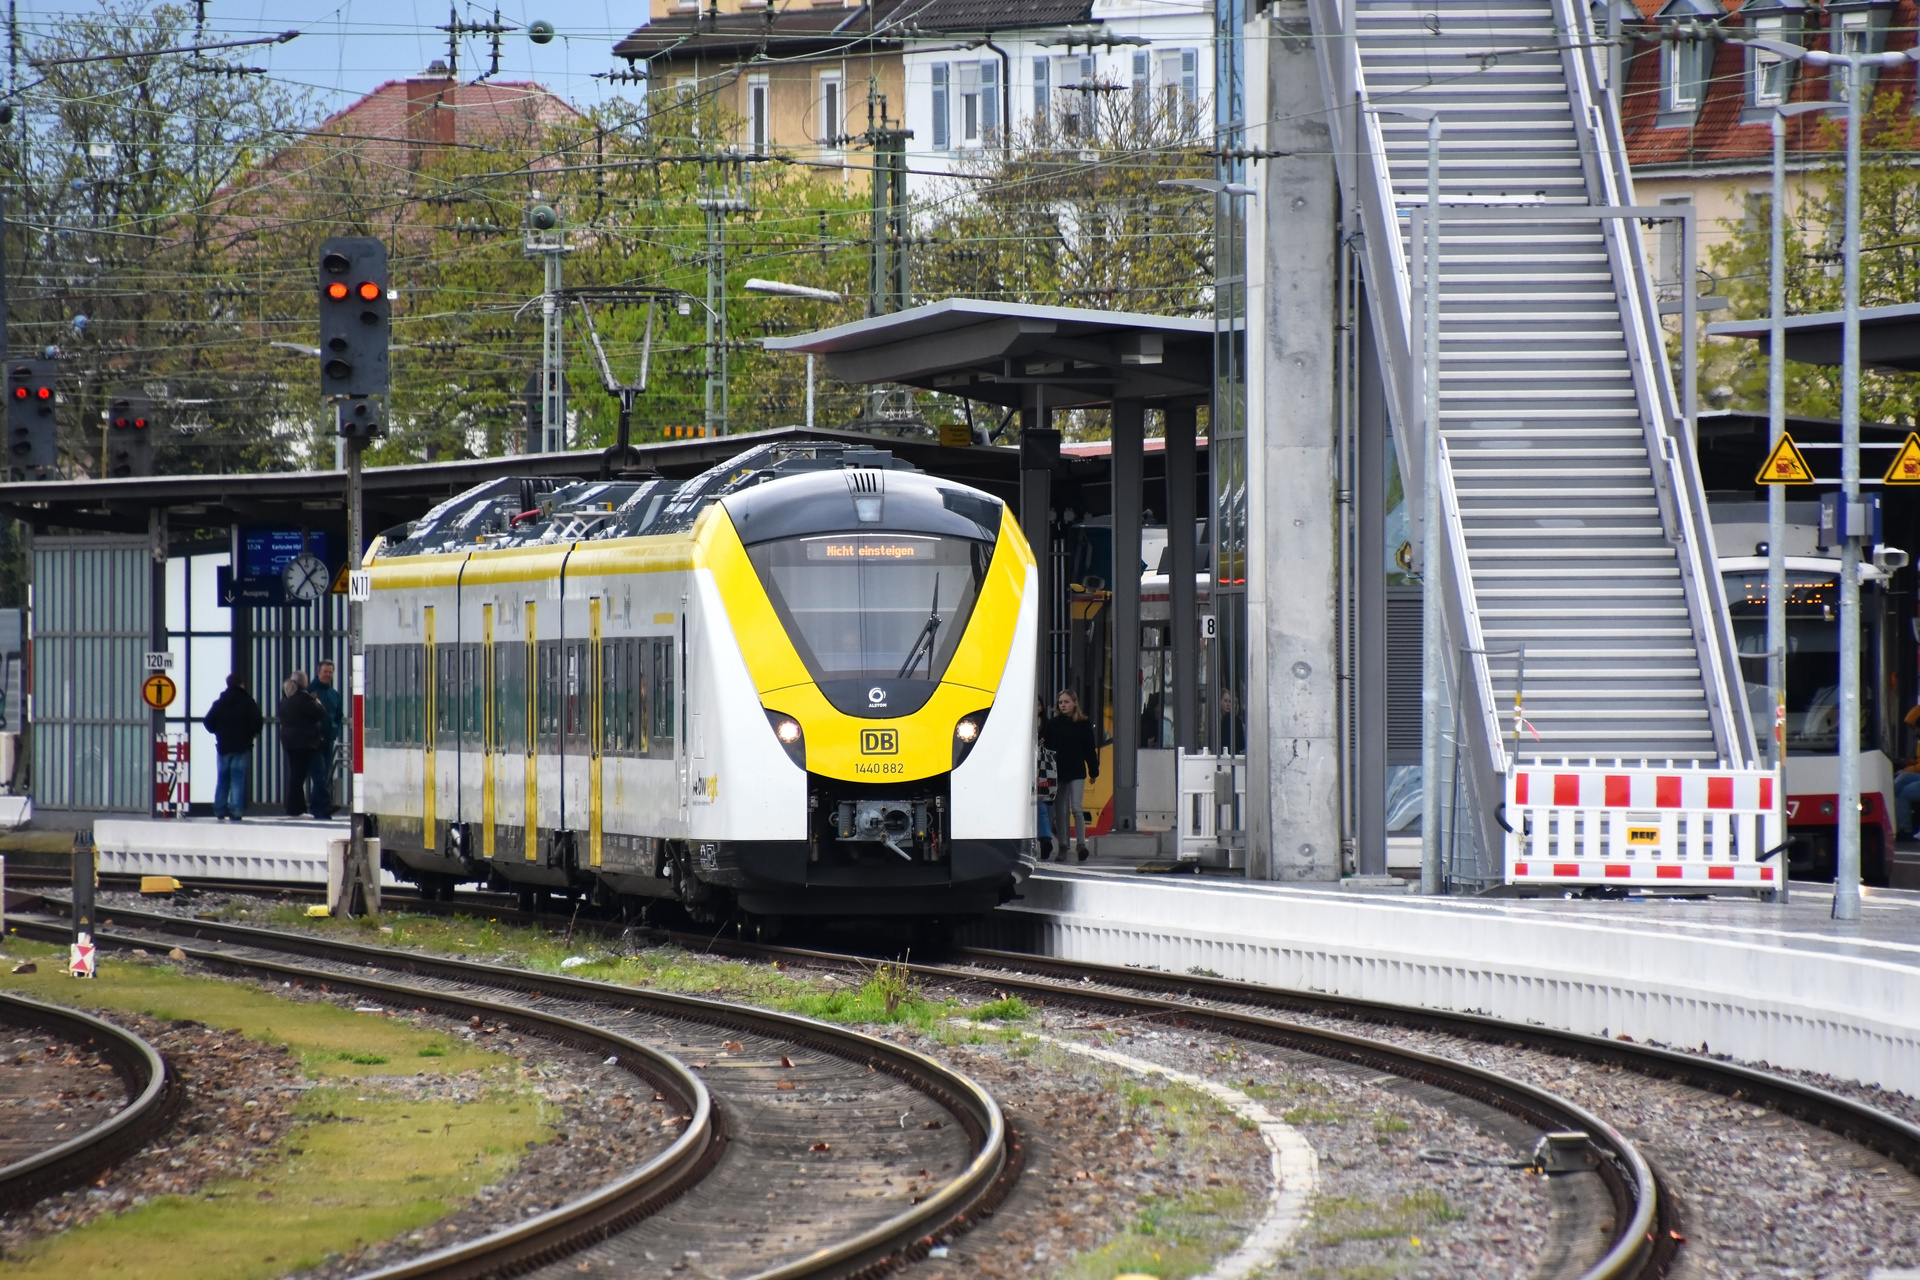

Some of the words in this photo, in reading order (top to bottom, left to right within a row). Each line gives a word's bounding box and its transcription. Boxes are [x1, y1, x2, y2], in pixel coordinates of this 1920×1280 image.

[826, 545, 854, 556] Nicht
[858, 545, 914, 558] einsteigen
[351, 576, 368, 595] N11
[1207, 618, 1215, 635] 8
[864, 732, 895, 752] DB
[855, 763, 880, 774] 1440
[882, 763, 904, 774] 882
